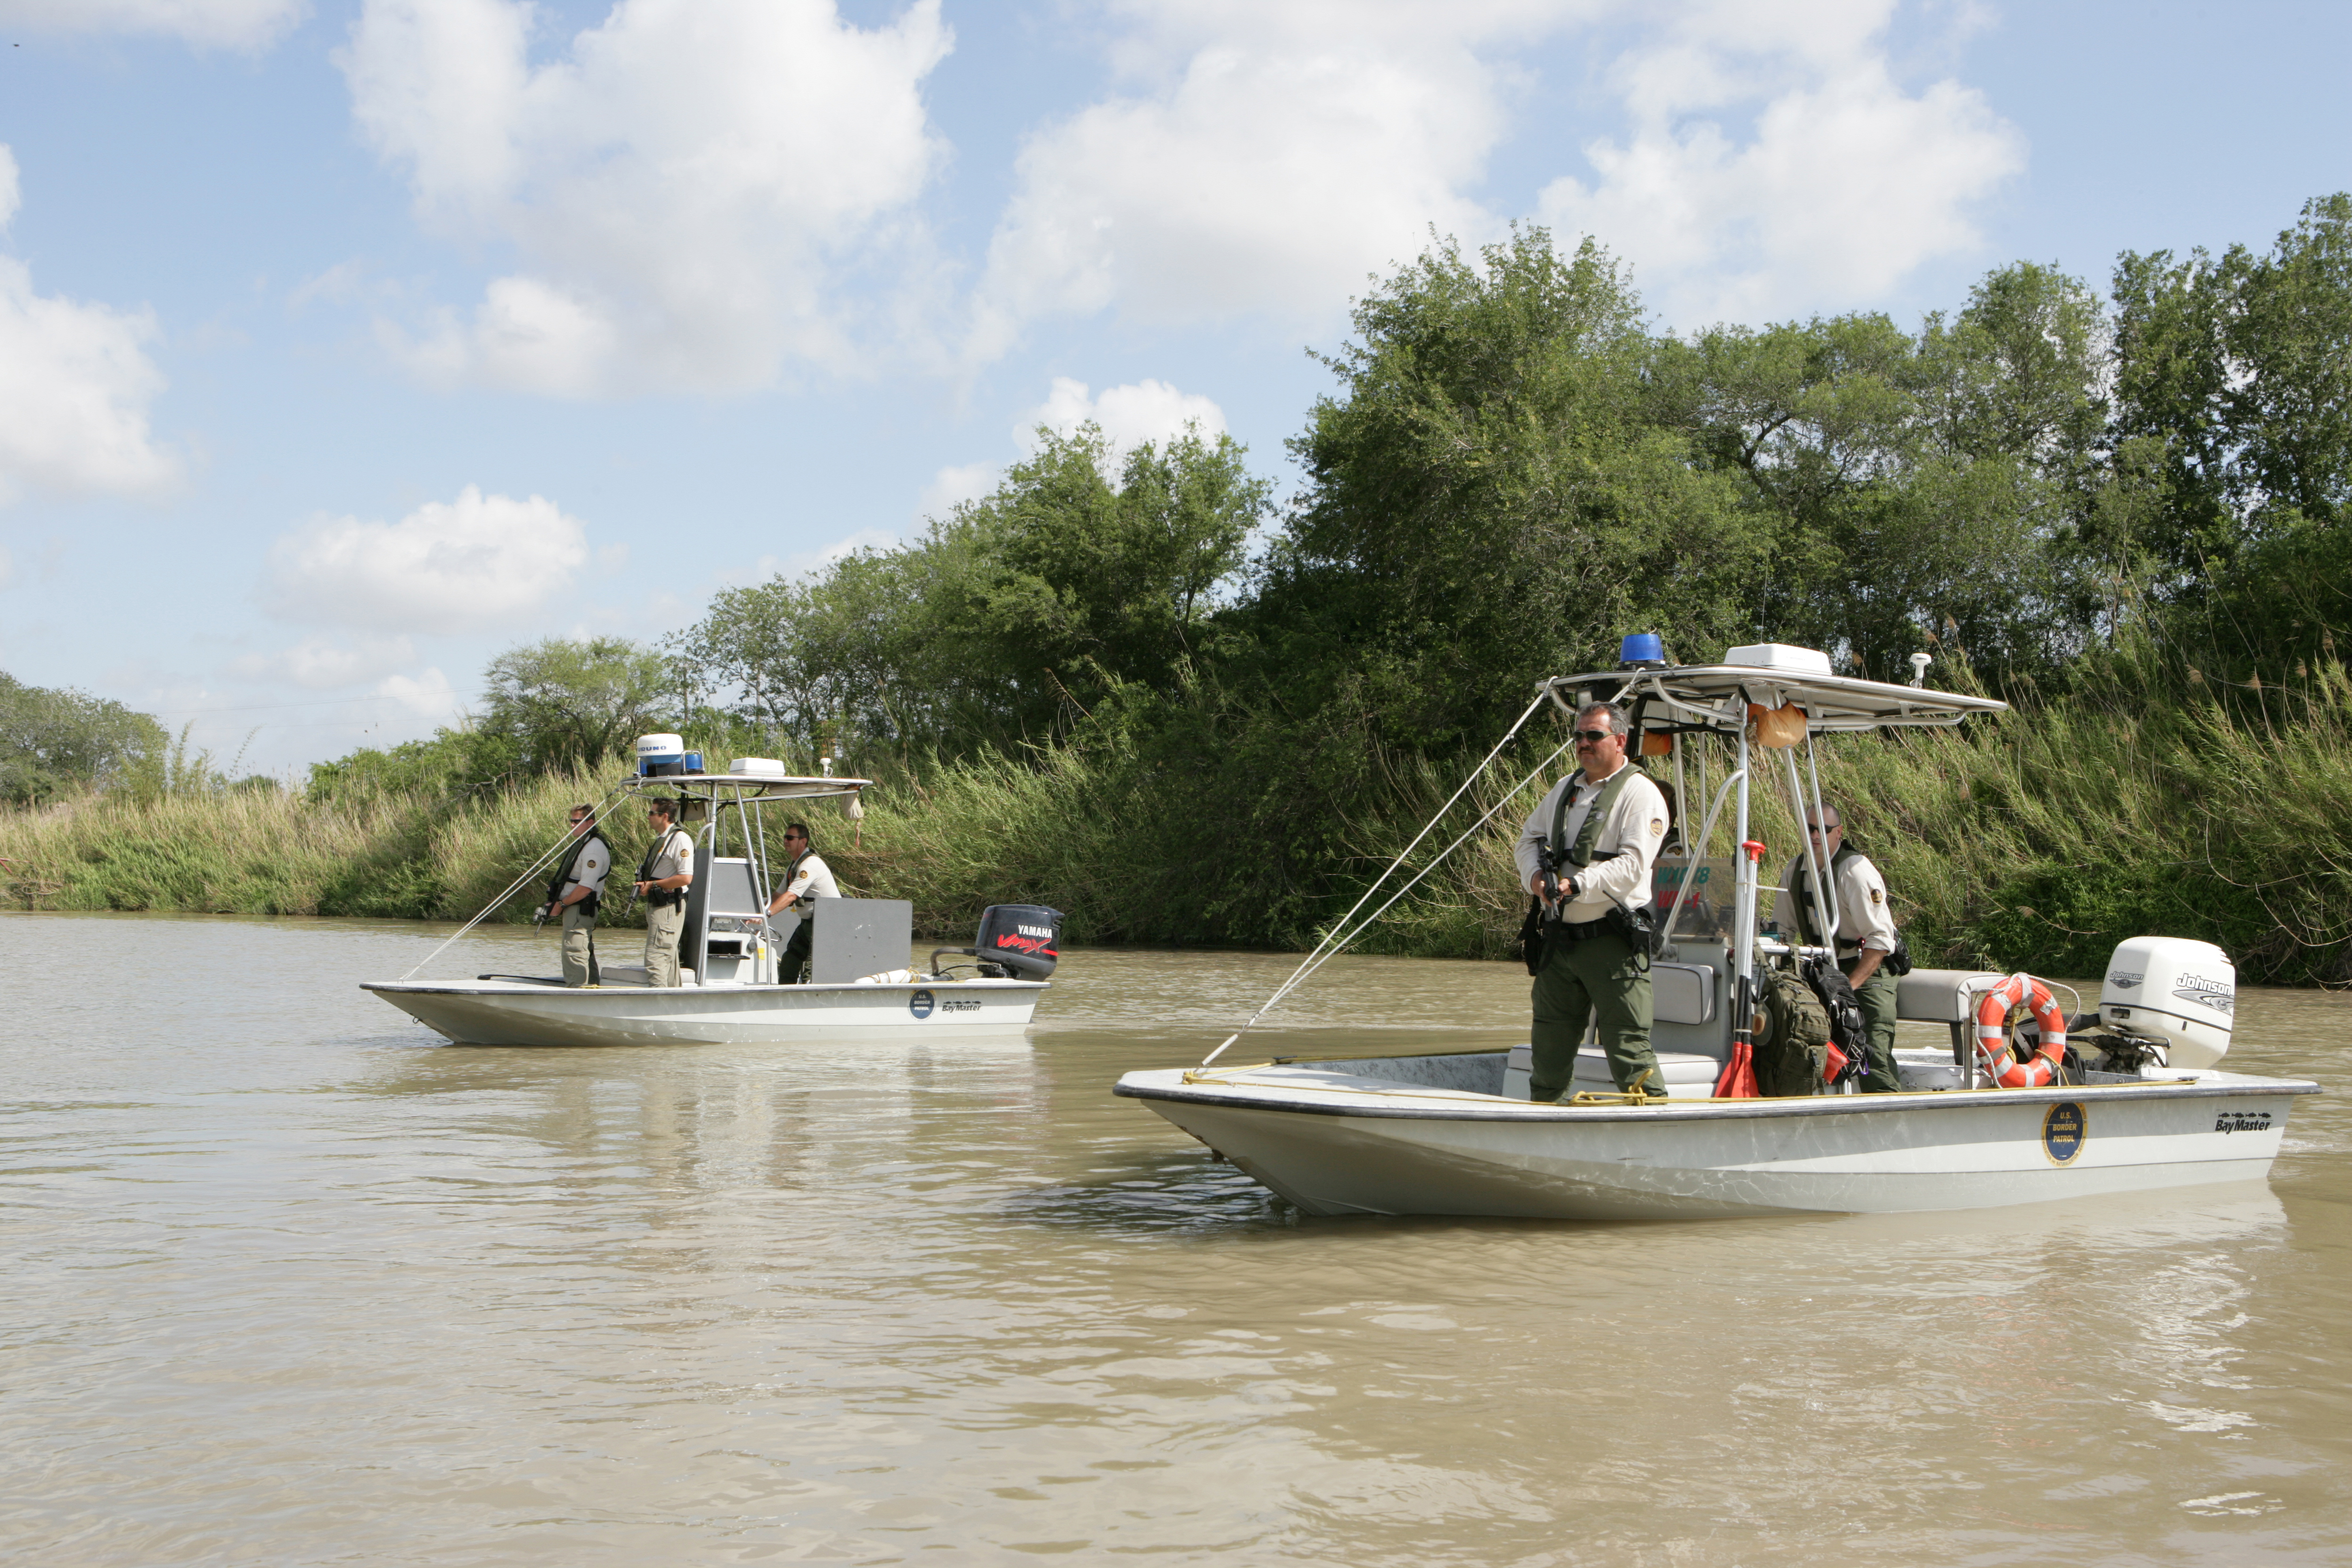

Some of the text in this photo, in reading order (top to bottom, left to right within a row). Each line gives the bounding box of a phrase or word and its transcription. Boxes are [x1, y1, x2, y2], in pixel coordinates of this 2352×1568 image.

[1018, 924, 1052, 939] YAMAHA
[2110, 971, 2144, 980] Johnson
[2177, 973, 2231, 996] Johnson
[2052, 1123, 2077, 1131] BORDER
